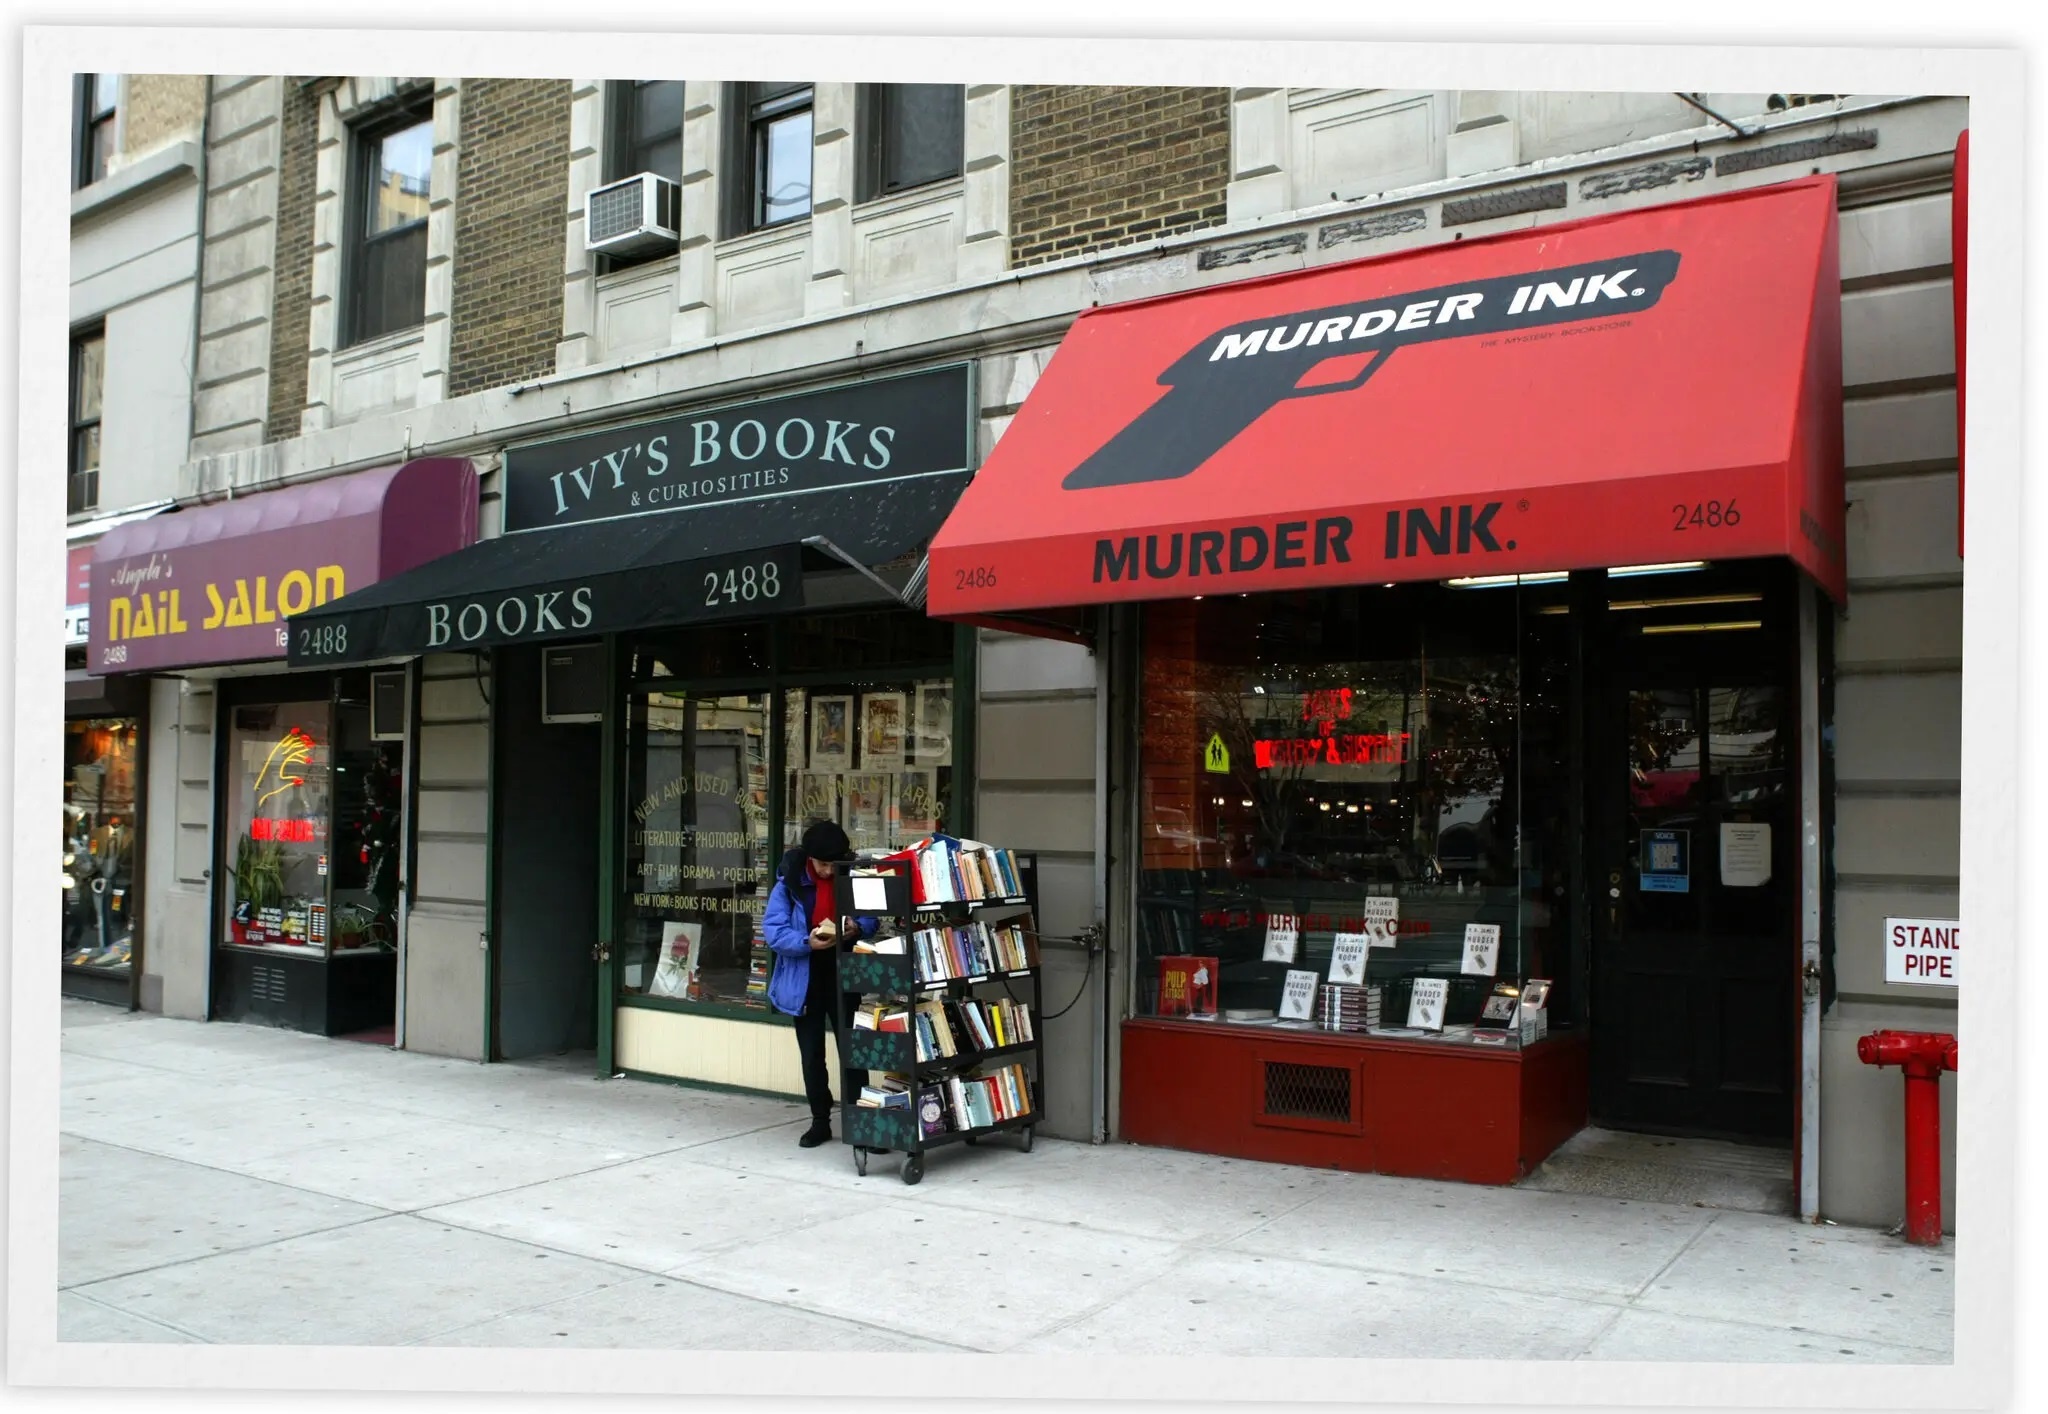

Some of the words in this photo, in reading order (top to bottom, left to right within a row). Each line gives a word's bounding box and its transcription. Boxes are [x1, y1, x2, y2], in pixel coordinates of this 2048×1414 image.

[1209, 291, 1486, 363] MURDER
[1504, 331, 1555, 345] MYSTERY
[1560, 319, 1633, 336] BOOKSTORE
[550, 435, 669, 516] IVY'S
[690, 417, 896, 470] BOOKS
[630, 490, 641, 506] &
[648, 467, 790, 505] CURIOSITIES
[1671, 498, 1742, 532] 2486
[1092, 515, 1355, 584] MURDER
[110, 553, 173, 596] Angela's
[703, 561, 781, 607] 2488
[955, 566, 997, 590] 2486
[426, 587, 594, 647] BOOKS
[300, 624, 348, 656] 2488
[634, 791, 660, 824] NEW
[663, 776, 688, 801] AND
[695, 774, 728, 797] USED
[634, 830, 687, 848] LITERATURE
[637, 863, 654, 876] ART
[658, 863, 679, 878] FILM
[683, 865, 716, 880] DRAMA
[723, 867, 761, 882] POETRY
[634, 893, 651, 907] NEW
[674, 895, 699, 910] BOOKS
[701, 897, 718, 911] FOR
[721, 899, 764, 914] CHILDREN
[1366, 909, 1393, 917] MURDER
[1467, 935, 1495, 944] MURDER
[1905, 954, 1953, 978] PIPE
[1165, 970, 1187, 988] PULP
[1286, 981, 1312, 990] MURDER
[1289, 990, 1307, 998] ROOM
[1414, 990, 1441, 998] MURDER
[1416, 998, 1436, 1006] ROOM
